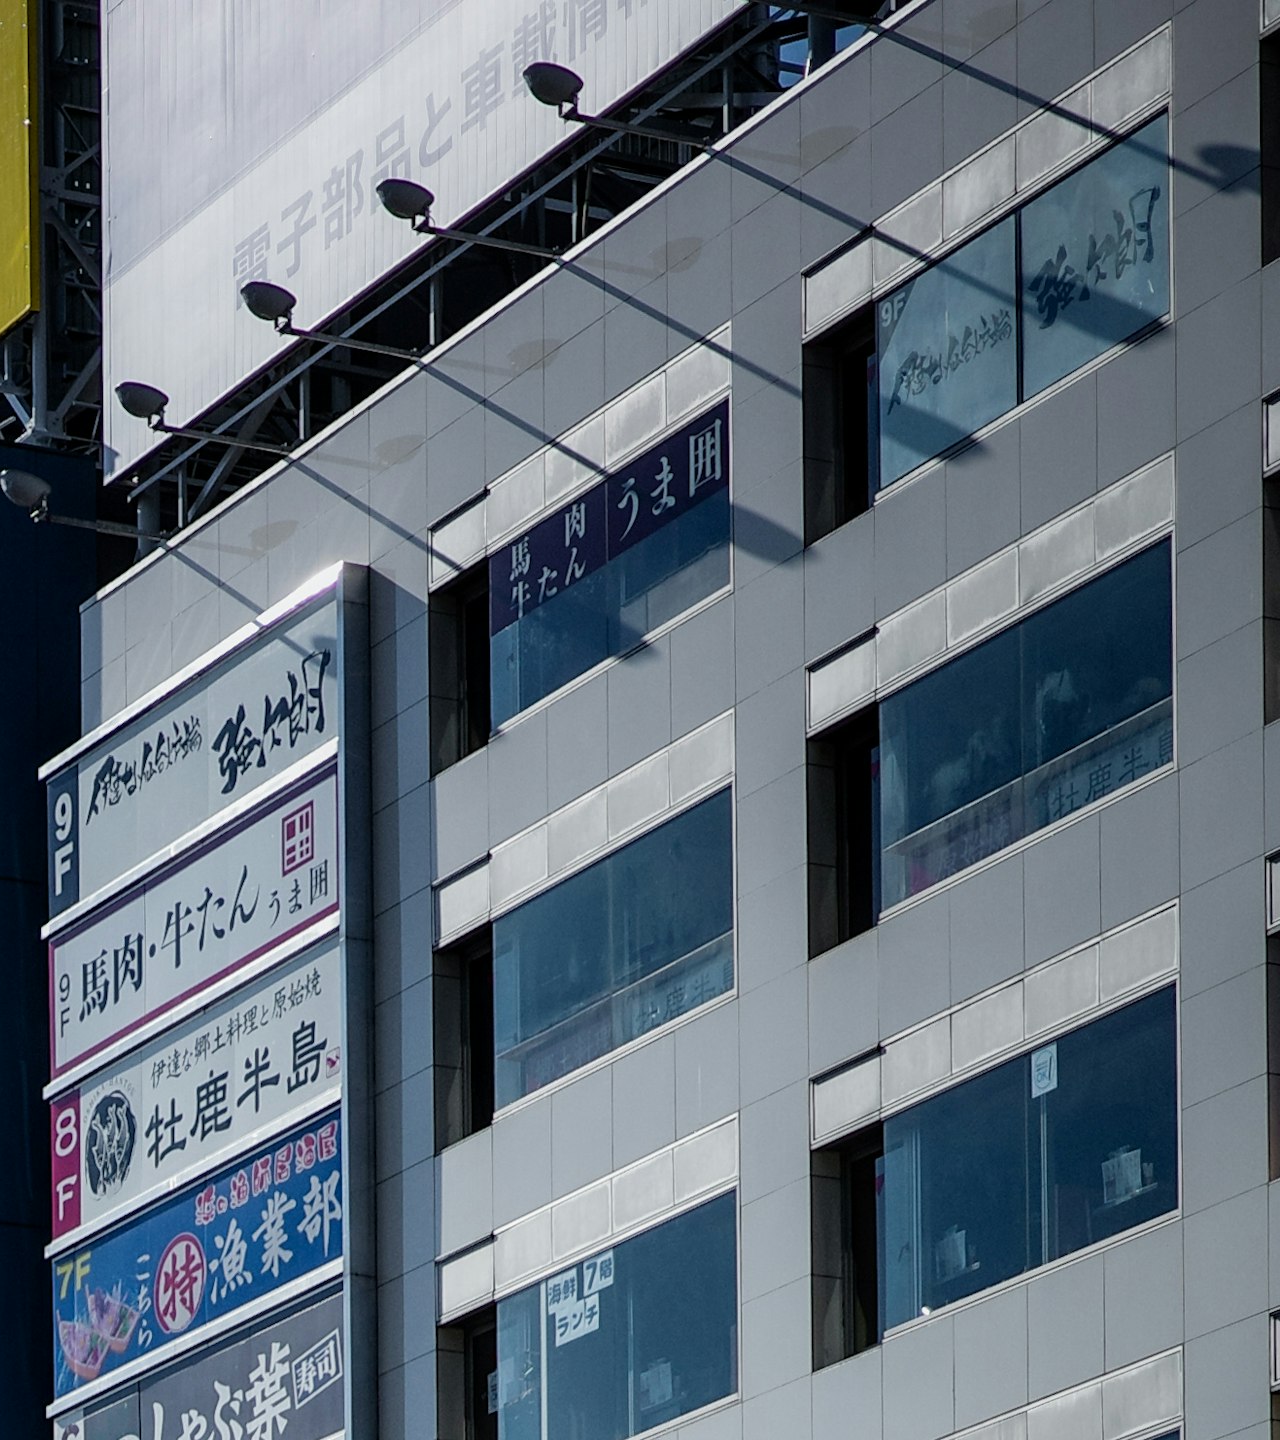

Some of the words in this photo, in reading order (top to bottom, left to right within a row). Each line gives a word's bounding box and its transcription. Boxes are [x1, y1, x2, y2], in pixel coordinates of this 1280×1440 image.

[232, 0, 652, 312] 電子部品と車載情
[509, 547, 587, 621] 牛たん
[54, 792, 73, 896] 9F
[79, 864, 260, 1022] 馬肉・牛たん
[59, 973, 71, 1038] 9F
[151, 967, 322, 1088] 伊達な郷土料理と原始焼
[144, 1020, 328, 1169] 牡鹿半島
[55, 1107, 78, 1221] 8F
[56, 1251, 91, 1300] 7F
[136, 1253, 153, 1348] こちら
[208, 1170, 342, 1305] 漁業部
[548, 1277, 576, 1305] 海鮮
[585, 1257, 614, 1291] 7階
[557, 1303, 598, 1337] ランチ
[295, 1340, 336, 1401] 寿司
